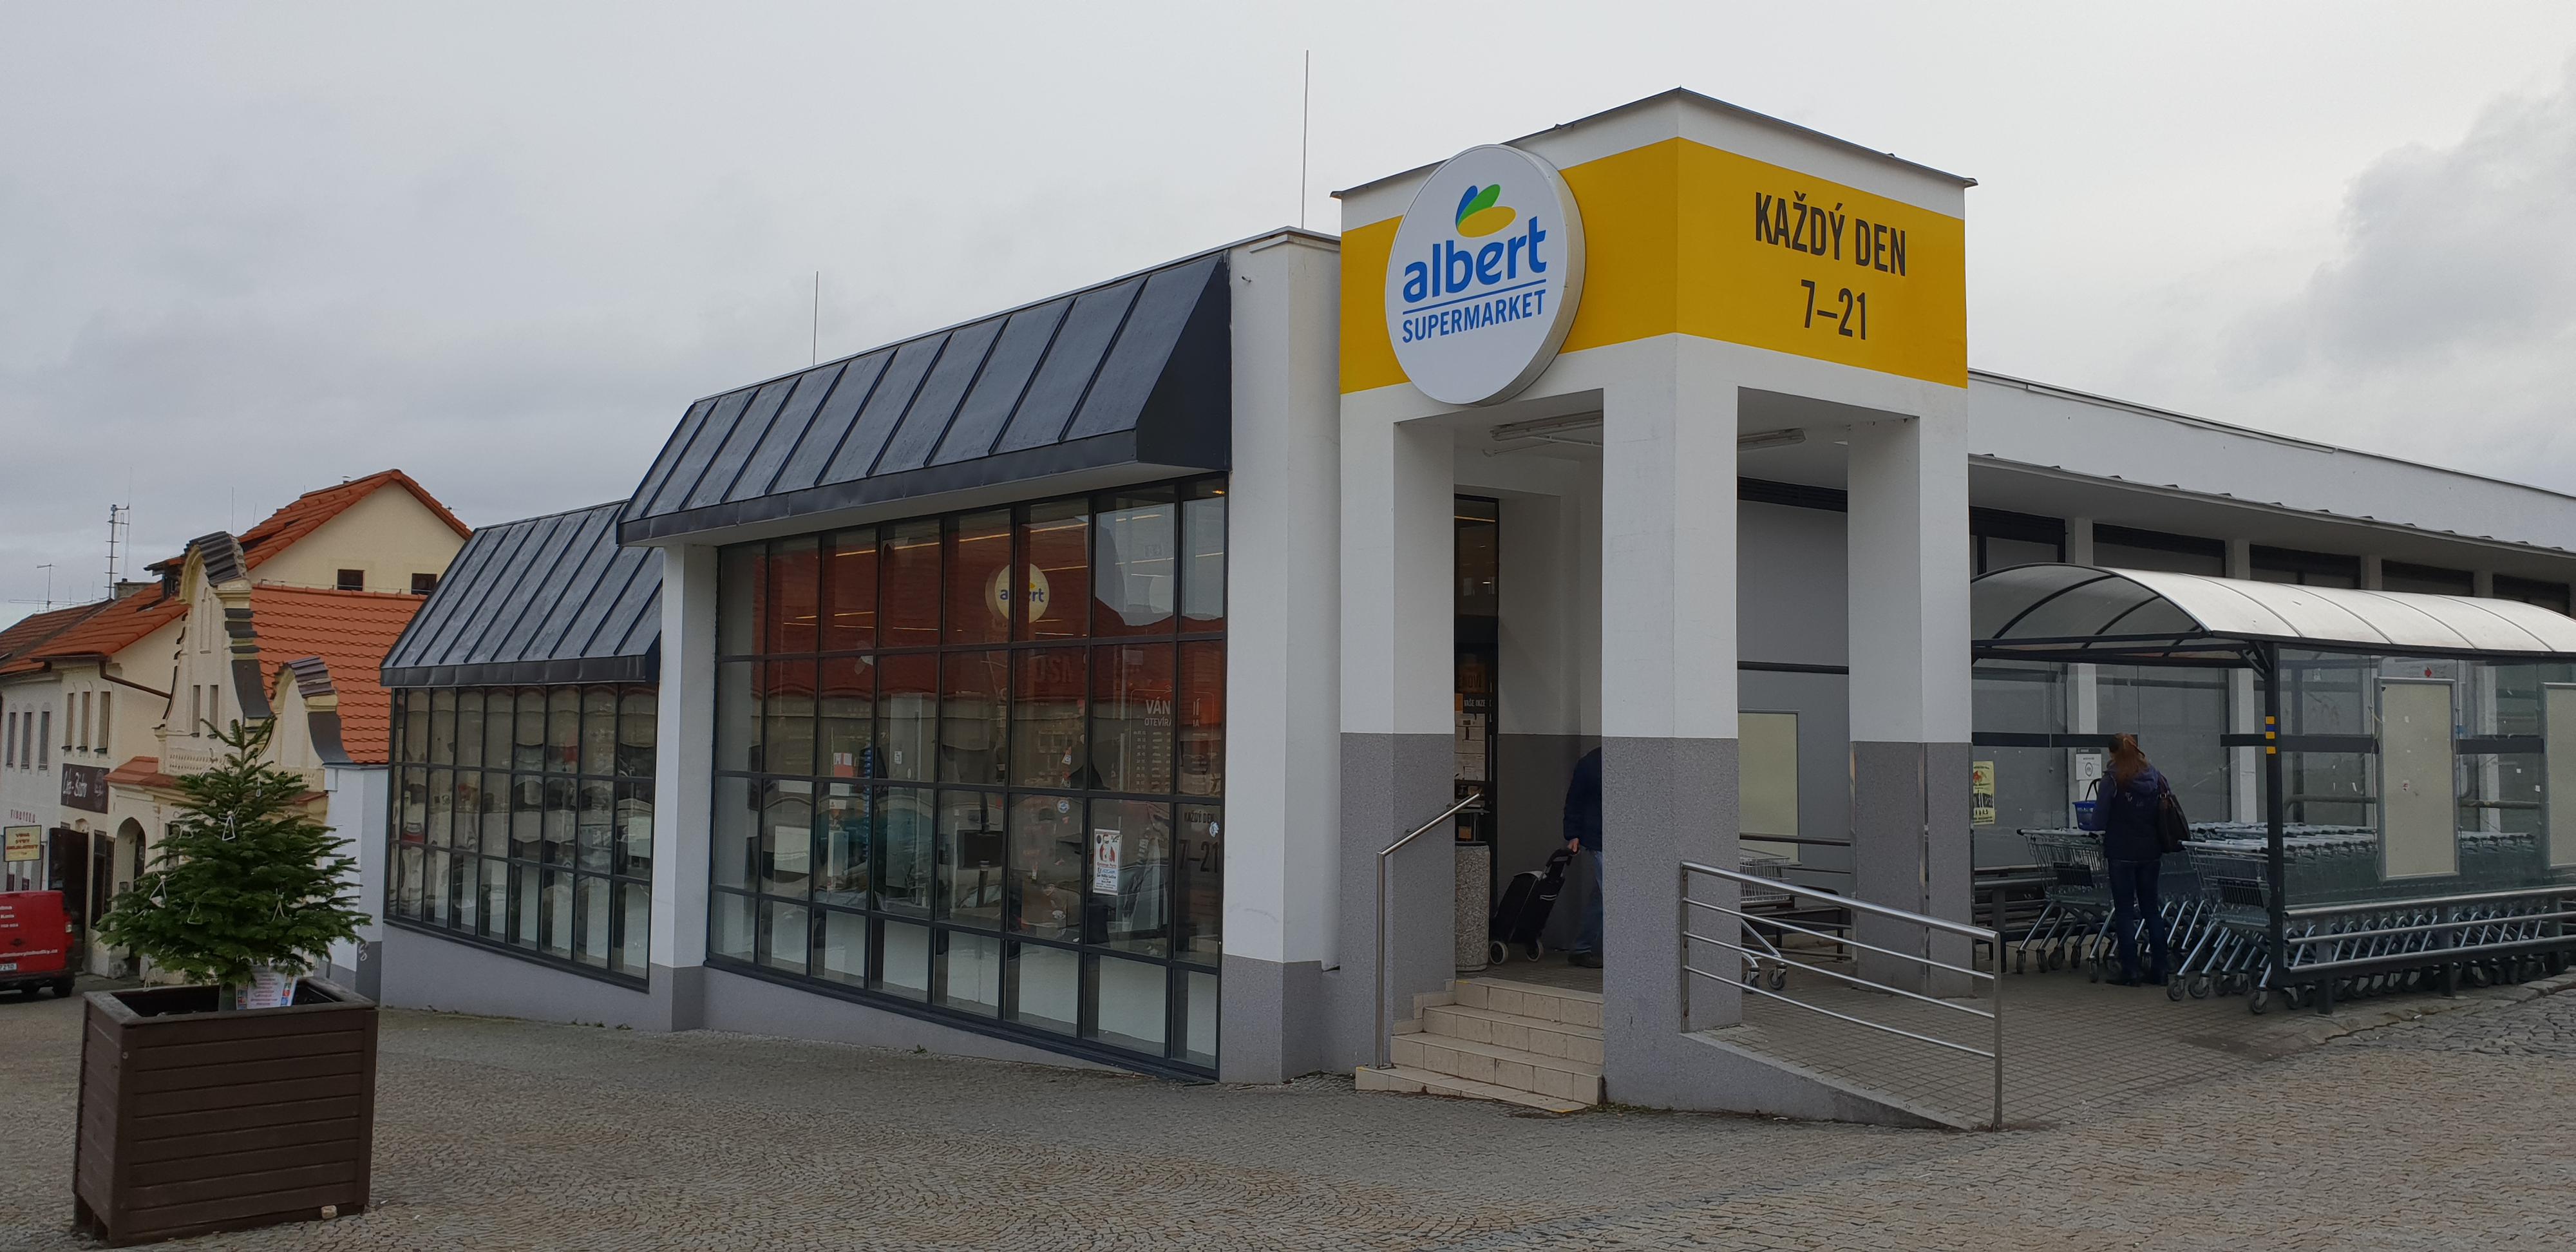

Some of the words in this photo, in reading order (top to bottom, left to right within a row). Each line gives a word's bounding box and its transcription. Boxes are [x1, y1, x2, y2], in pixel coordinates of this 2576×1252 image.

[1403, 216, 1547, 303] albert
[1756, 191, 1845, 261] KAŽDÝ
[1855, 218, 1906, 277] DEN
[1402, 289, 1546, 343] SUPERMARKET
[999, 589, 1045, 603] art
